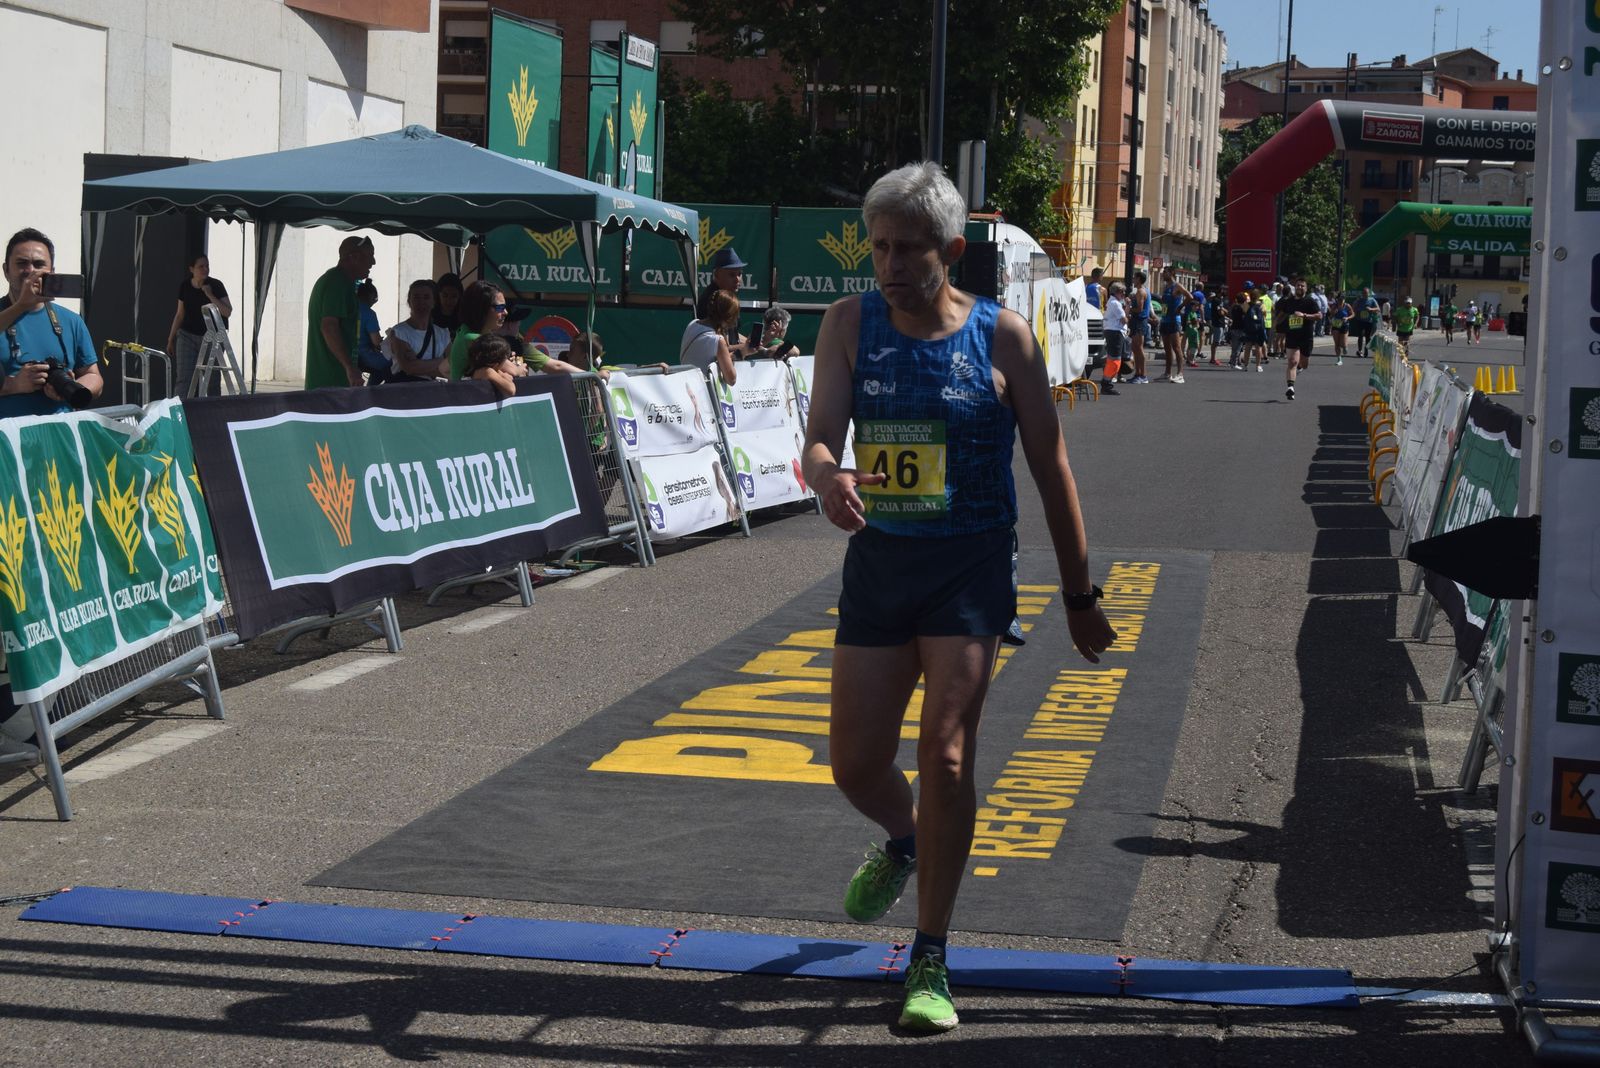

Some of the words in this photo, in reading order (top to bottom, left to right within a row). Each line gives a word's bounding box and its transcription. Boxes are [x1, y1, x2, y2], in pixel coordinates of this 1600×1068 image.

[1436, 117, 1468, 131] CON
[1471, 119, 1489, 132] EL
[1375, 127, 1420, 139] ZAMORA
[1435, 134, 1505, 149] GANAMOS
[1454, 213, 1494, 228] CAJA
[1447, 239, 1516, 252] SALIDA
[498, 263, 541, 281] CAJA
[641, 269, 688, 287] CAJA
[697, 271, 758, 290] RUAL
[790, 275, 837, 293] CAJA
[874, 433, 897, 442] CAJA
[899, 433, 933, 442] RURAL
[871, 449, 919, 489] 46
[365, 461, 444, 533] CAJA
[437, 447, 535, 520] RURAL
[876, 501, 901, 512] CAJA
[902, 501, 941, 512] RURAL
[1023, 667, 1129, 742] INTEGRAL
[969, 750, 1097, 860] REFORMA
